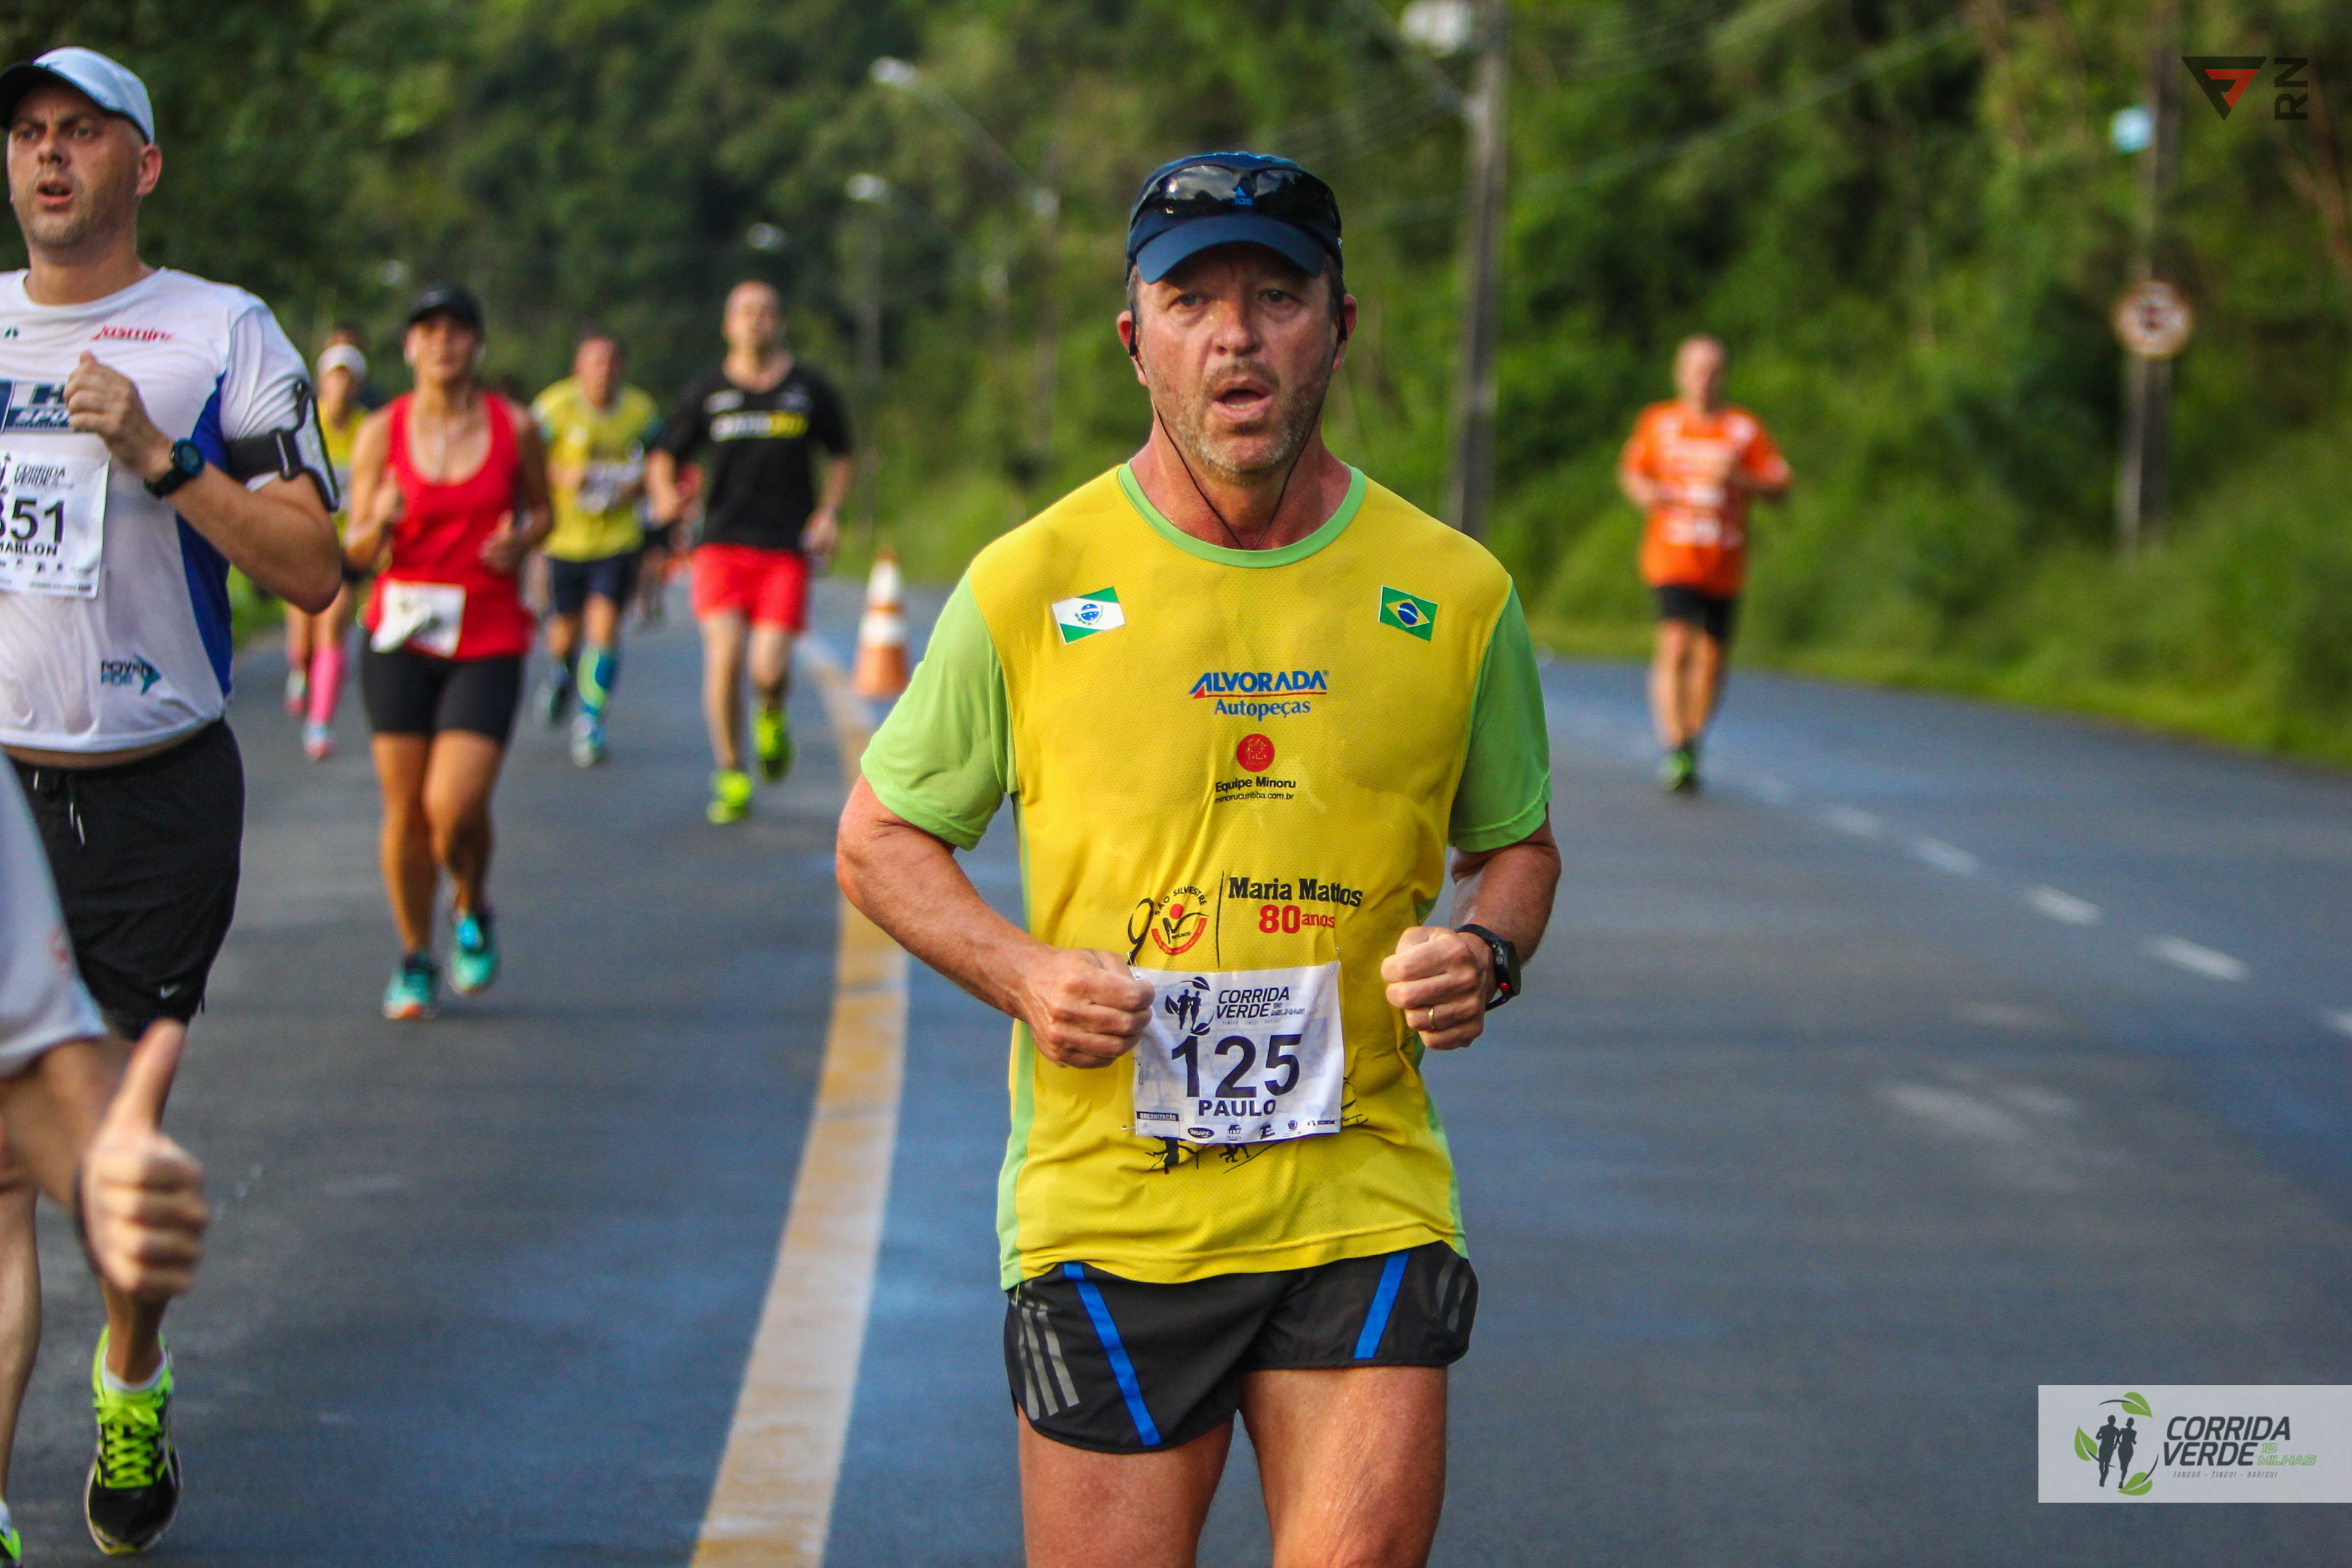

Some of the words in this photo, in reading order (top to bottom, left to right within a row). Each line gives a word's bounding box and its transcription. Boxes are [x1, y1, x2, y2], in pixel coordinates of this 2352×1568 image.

[1189, 670, 1328, 695] ALVORADA
[1214, 698, 1311, 722] Autopeças
[1215, 778, 1252, 793] Equipe
[1256, 776, 1297, 788] Minoru
[1173, 886, 1207, 906] SILVESTRE
[1228, 877, 1292, 901] Maria
[1299, 878, 1363, 907] Mattos
[1218, 987, 1289, 1004] CORRIDA
[1217, 1003, 1271, 1019] VERDE
[1172, 1033, 1302, 1098] 125
[1199, 1099, 1277, 1116] PAULO
[1140, 1113, 1177, 1122] ORGANIZAÇÃO
